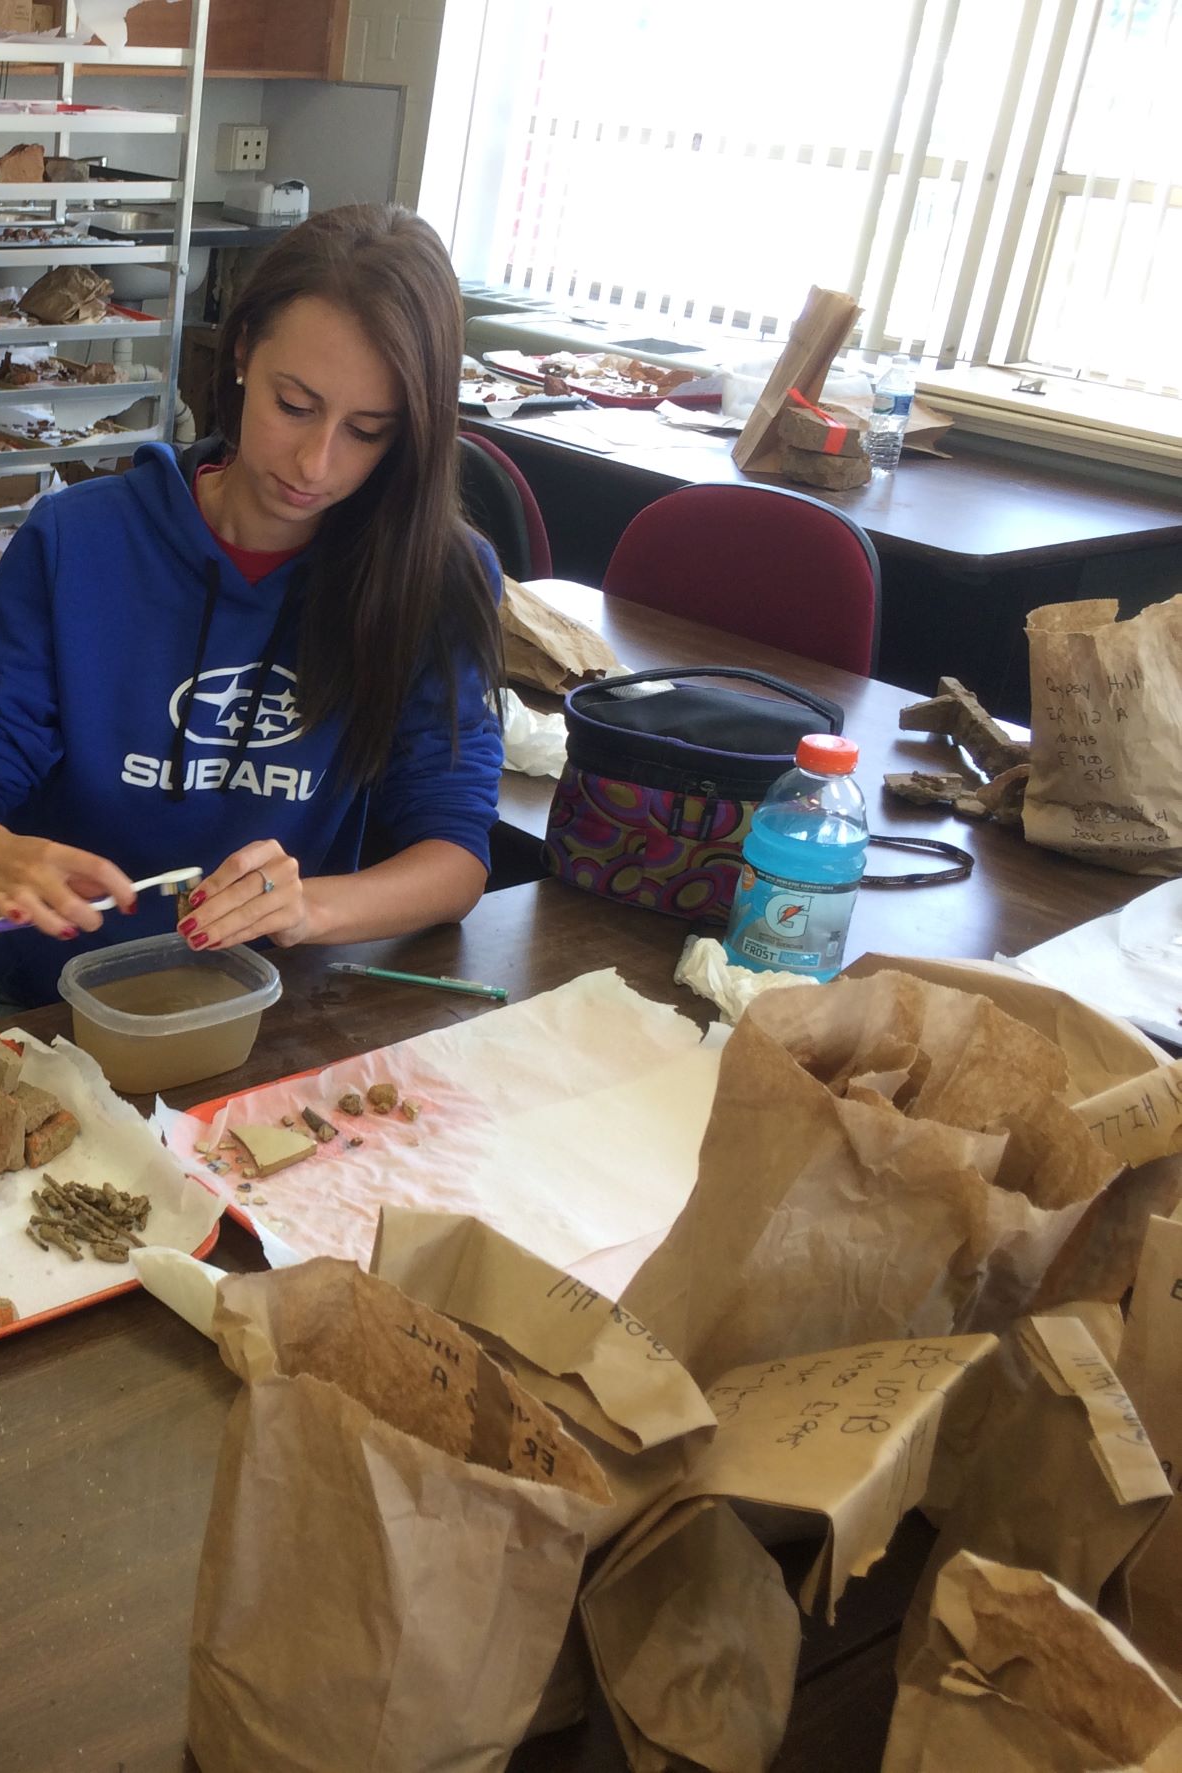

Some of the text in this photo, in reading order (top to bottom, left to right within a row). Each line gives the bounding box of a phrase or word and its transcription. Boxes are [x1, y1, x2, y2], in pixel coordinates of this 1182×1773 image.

[1107, 669, 1140, 693] Hill
[1117, 707, 1128, 722] A
[744, 943, 776, 961] FROST
[1089, 1093, 1159, 1147] HILL
[840, 1414, 891, 1434] B
